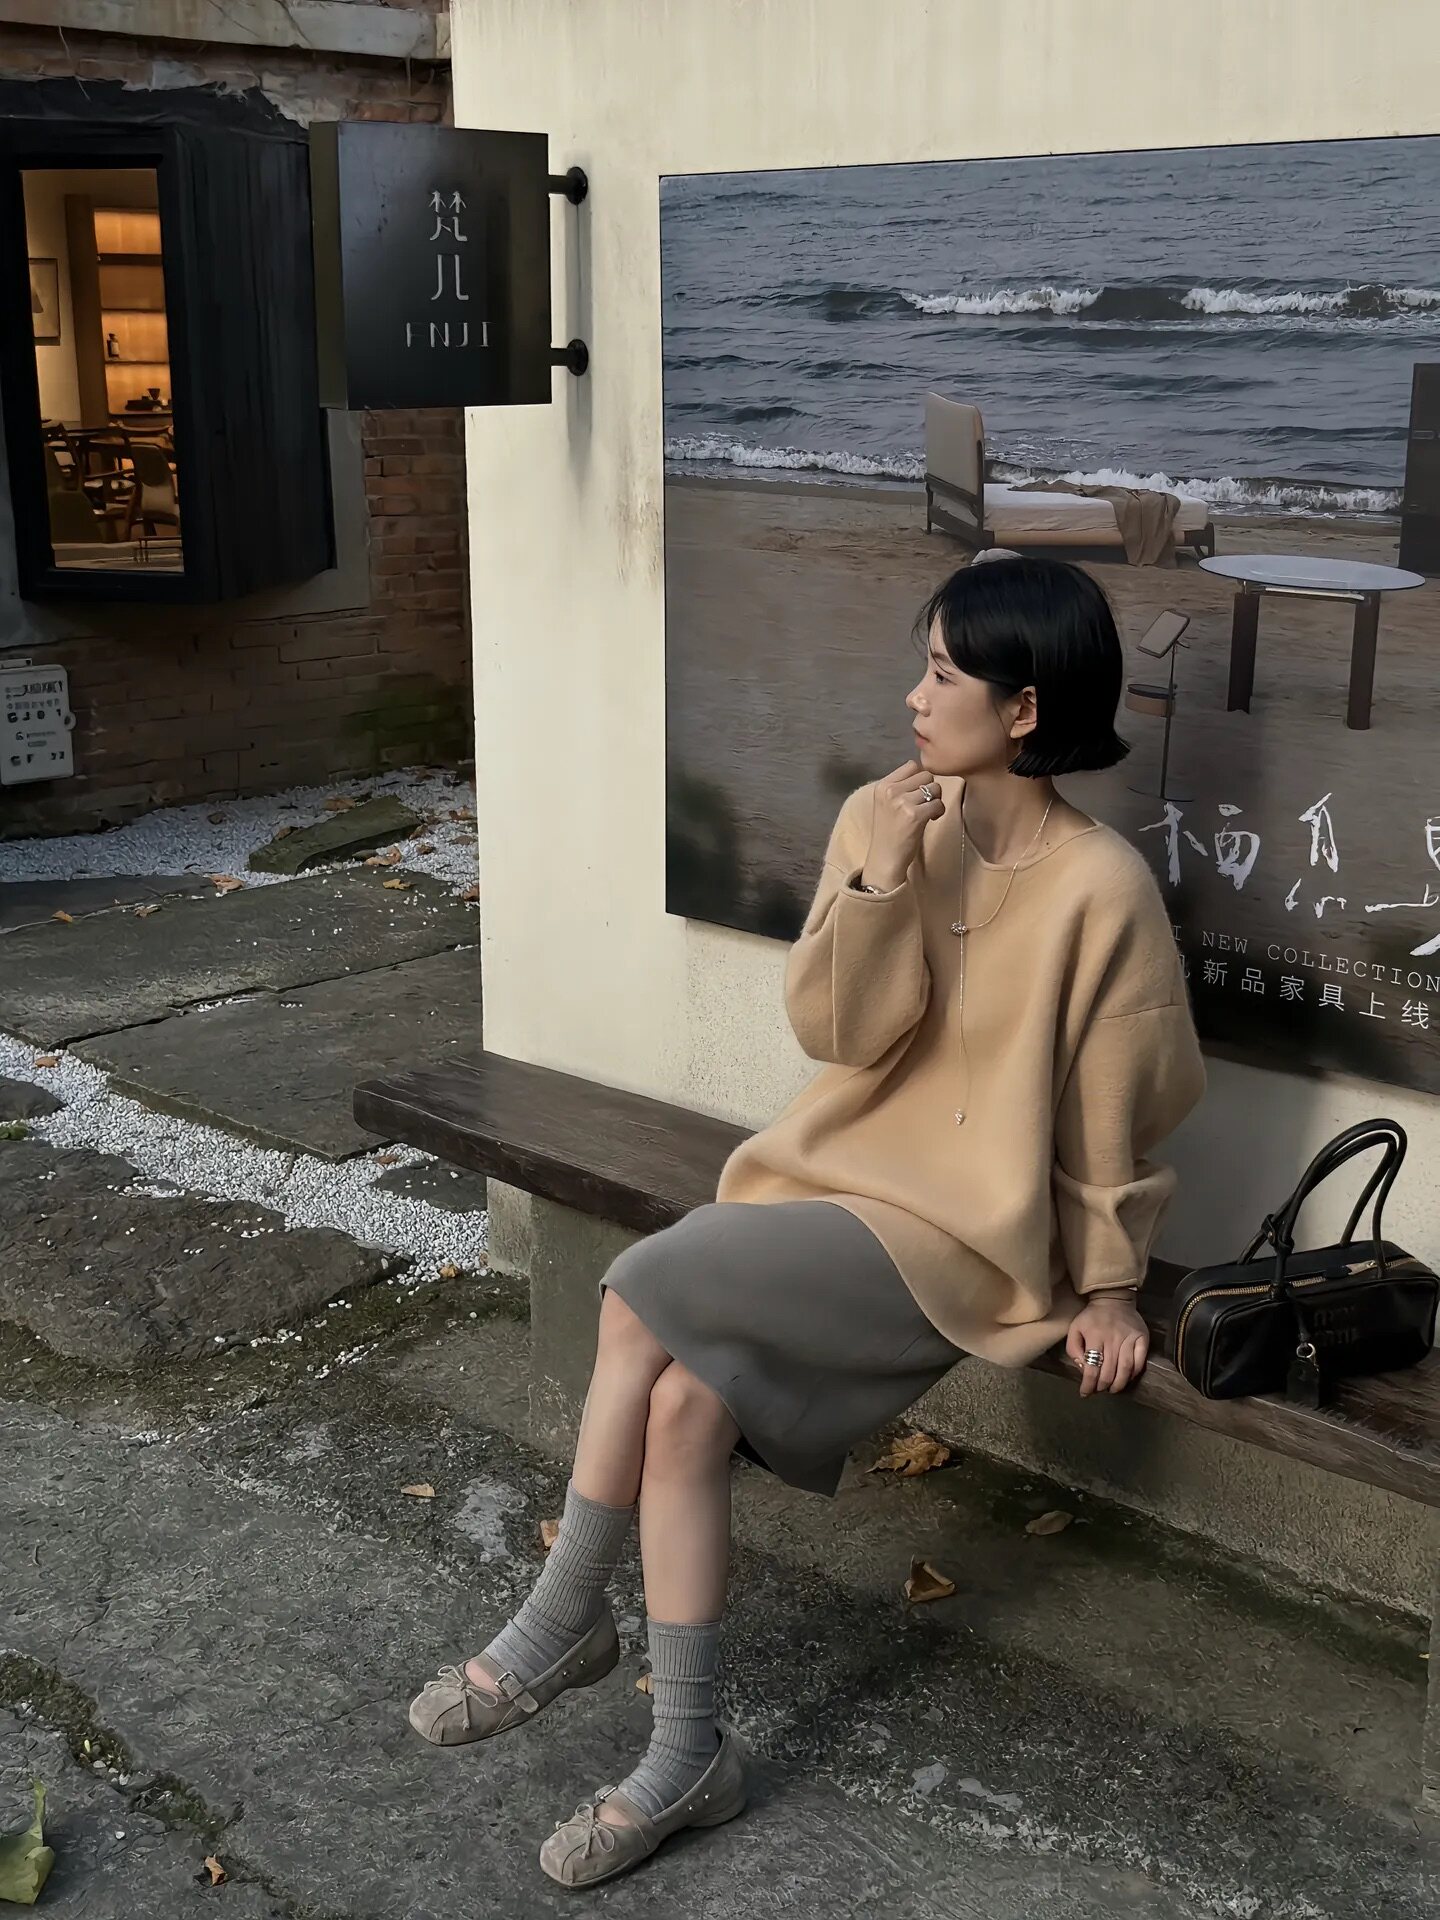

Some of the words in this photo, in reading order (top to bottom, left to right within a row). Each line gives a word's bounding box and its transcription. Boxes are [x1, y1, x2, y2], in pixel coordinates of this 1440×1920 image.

[405, 321, 496, 348] FNJI
[1202, 931, 1248, 954] NEW
[1267, 944, 1440, 993] COLLECTION
